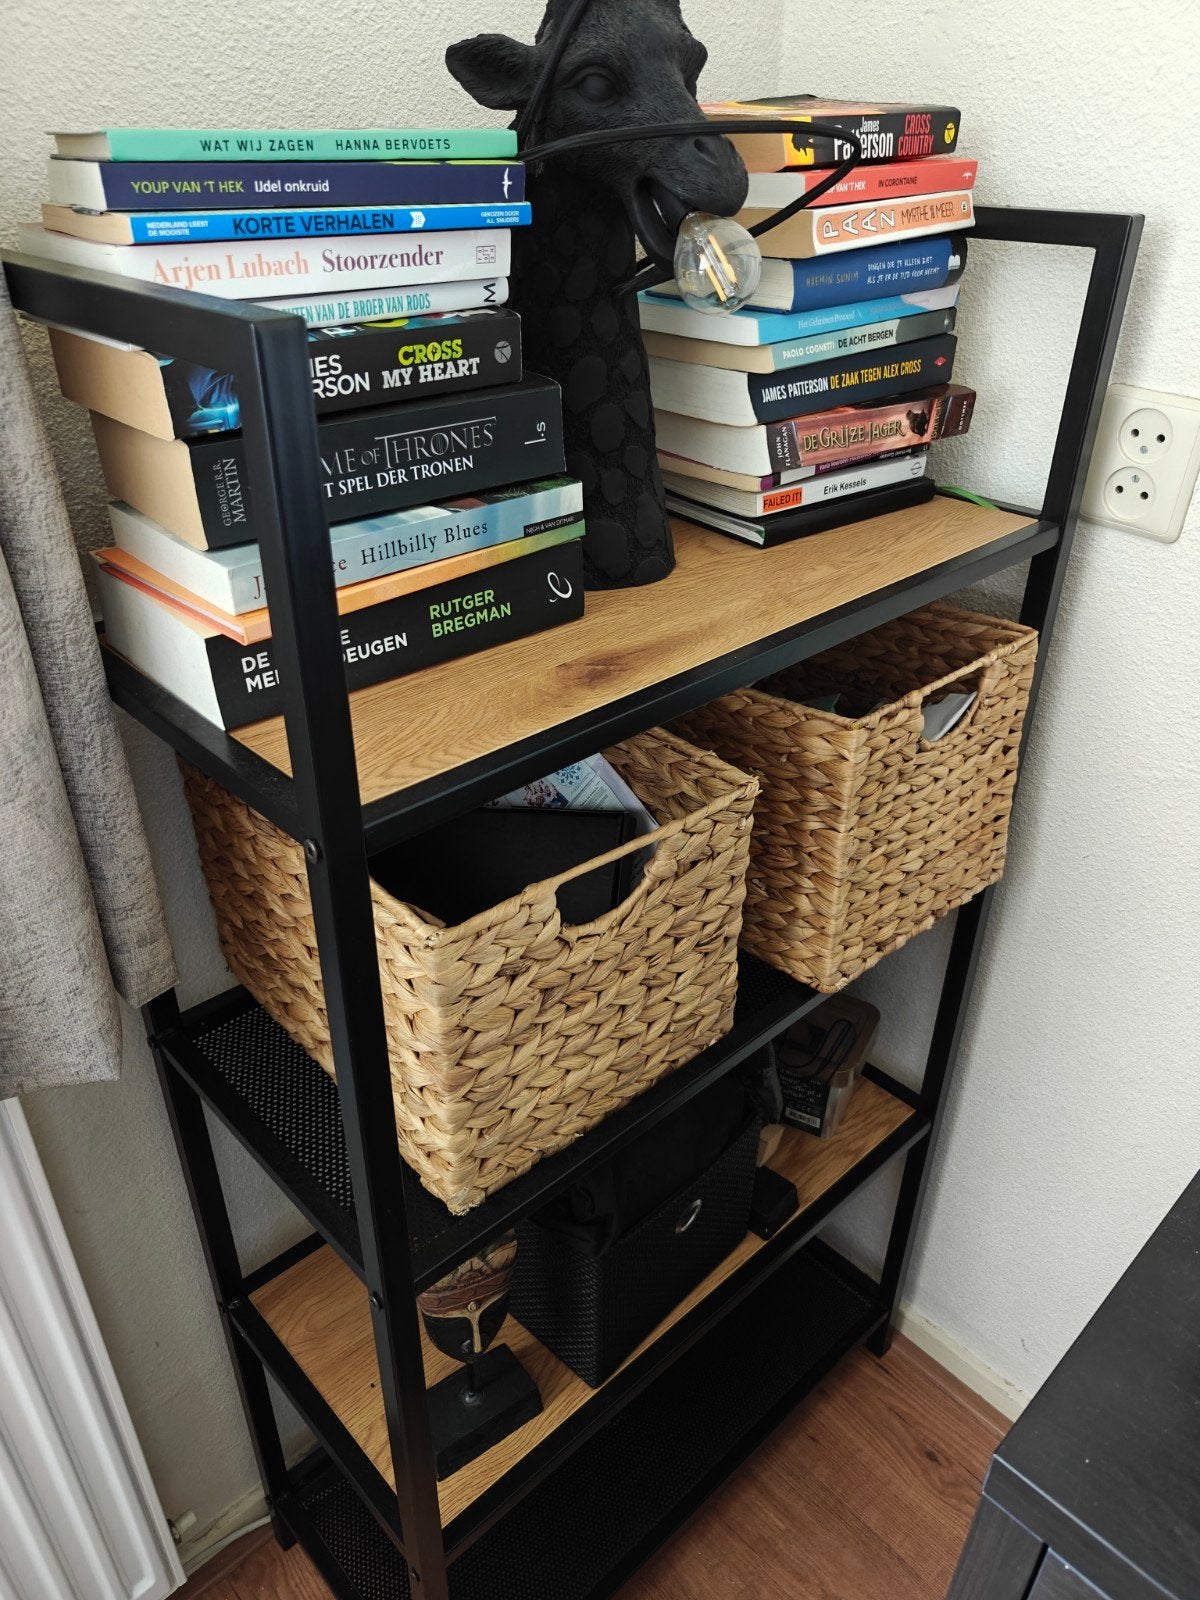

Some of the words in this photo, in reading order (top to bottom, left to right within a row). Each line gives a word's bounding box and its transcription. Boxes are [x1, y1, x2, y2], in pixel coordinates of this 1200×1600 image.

[860, 116, 880, 132] James
[904, 113, 932, 135] CROSS
[200, 139, 230, 152] WAT
[237, 139, 262, 151] WIJ
[268, 139, 315, 152] ZAGEN
[335, 139, 380, 150] HANNA
[385, 138, 451, 150] BERVOETS
[833, 124, 894, 161] Paerson
[897, 134, 935, 156] COUNTRY
[130, 181, 170, 194] YOUP
[172, 181, 201, 193] VAN
[203, 180, 215, 193] 'T
[218, 181, 245, 193] HEK
[284, 179, 330, 193] onkruid
[935, 201, 955, 219] MEER
[146, 221, 188, 229] NEDERLAND
[189, 220, 209, 228] LEEST
[148, 229, 158, 237] DE
[233, 215, 295, 235] KORTE
[300, 212, 395, 232] VERHALEN
[153, 258, 222, 290] Arjen
[225, 250, 309, 280] Lubach
[321, 244, 444, 273] Stoorzender
[314, 303, 336, 322] VAN
[338, 301, 351, 319] DE
[353, 297, 384, 316] BROER
[386, 295, 404, 313] VAN
[406, 293, 431, 312] ROOS
[838, 338, 848, 348] DE
[848, 334, 867, 346] ACHT
[867, 329, 894, 343] BERGEN
[398, 338, 463, 366] CROSS
[782, 347, 804, 360] PAOLO
[805, 341, 835, 355] COGNETTI
[382, 366, 413, 389] MY
[418, 357, 480, 383] HEART
[830, 375, 840, 390] DE
[841, 371, 860, 387] ZAAK
[860, 366, 882, 384] TEGEN
[882, 362, 900, 380] ALEX
[900, 359, 922, 377] CROSS
[762, 384, 787, 404] JAMES
[787, 376, 829, 398] PATTERSON
[375, 416, 497, 469] THRONES
[776, 436, 784, 459] JOHN
[781, 426, 791, 467] FLANAGAN
[803, 435, 817, 452] DE
[338, 474, 374, 496] SPEL
[377, 467, 409, 488] DER
[409, 455, 475, 480] TRONEN
[823, 483, 838, 495] Erik
[840, 477, 867, 491] Kessels
[223, 458, 247, 523] MARTIN
[763, 493, 791, 509] FAILED
[791, 491, 802, 504] IT!
[216, 482, 231, 526] GEORGE
[361, 533, 437, 565] Hillbilly
[444, 521, 489, 544] Blues
[429, 589, 496, 620] RUTGER
[431, 602, 512, 638] BREGMAN
[342, 632, 408, 664] EUGEN
[241, 651, 271, 674] DE
